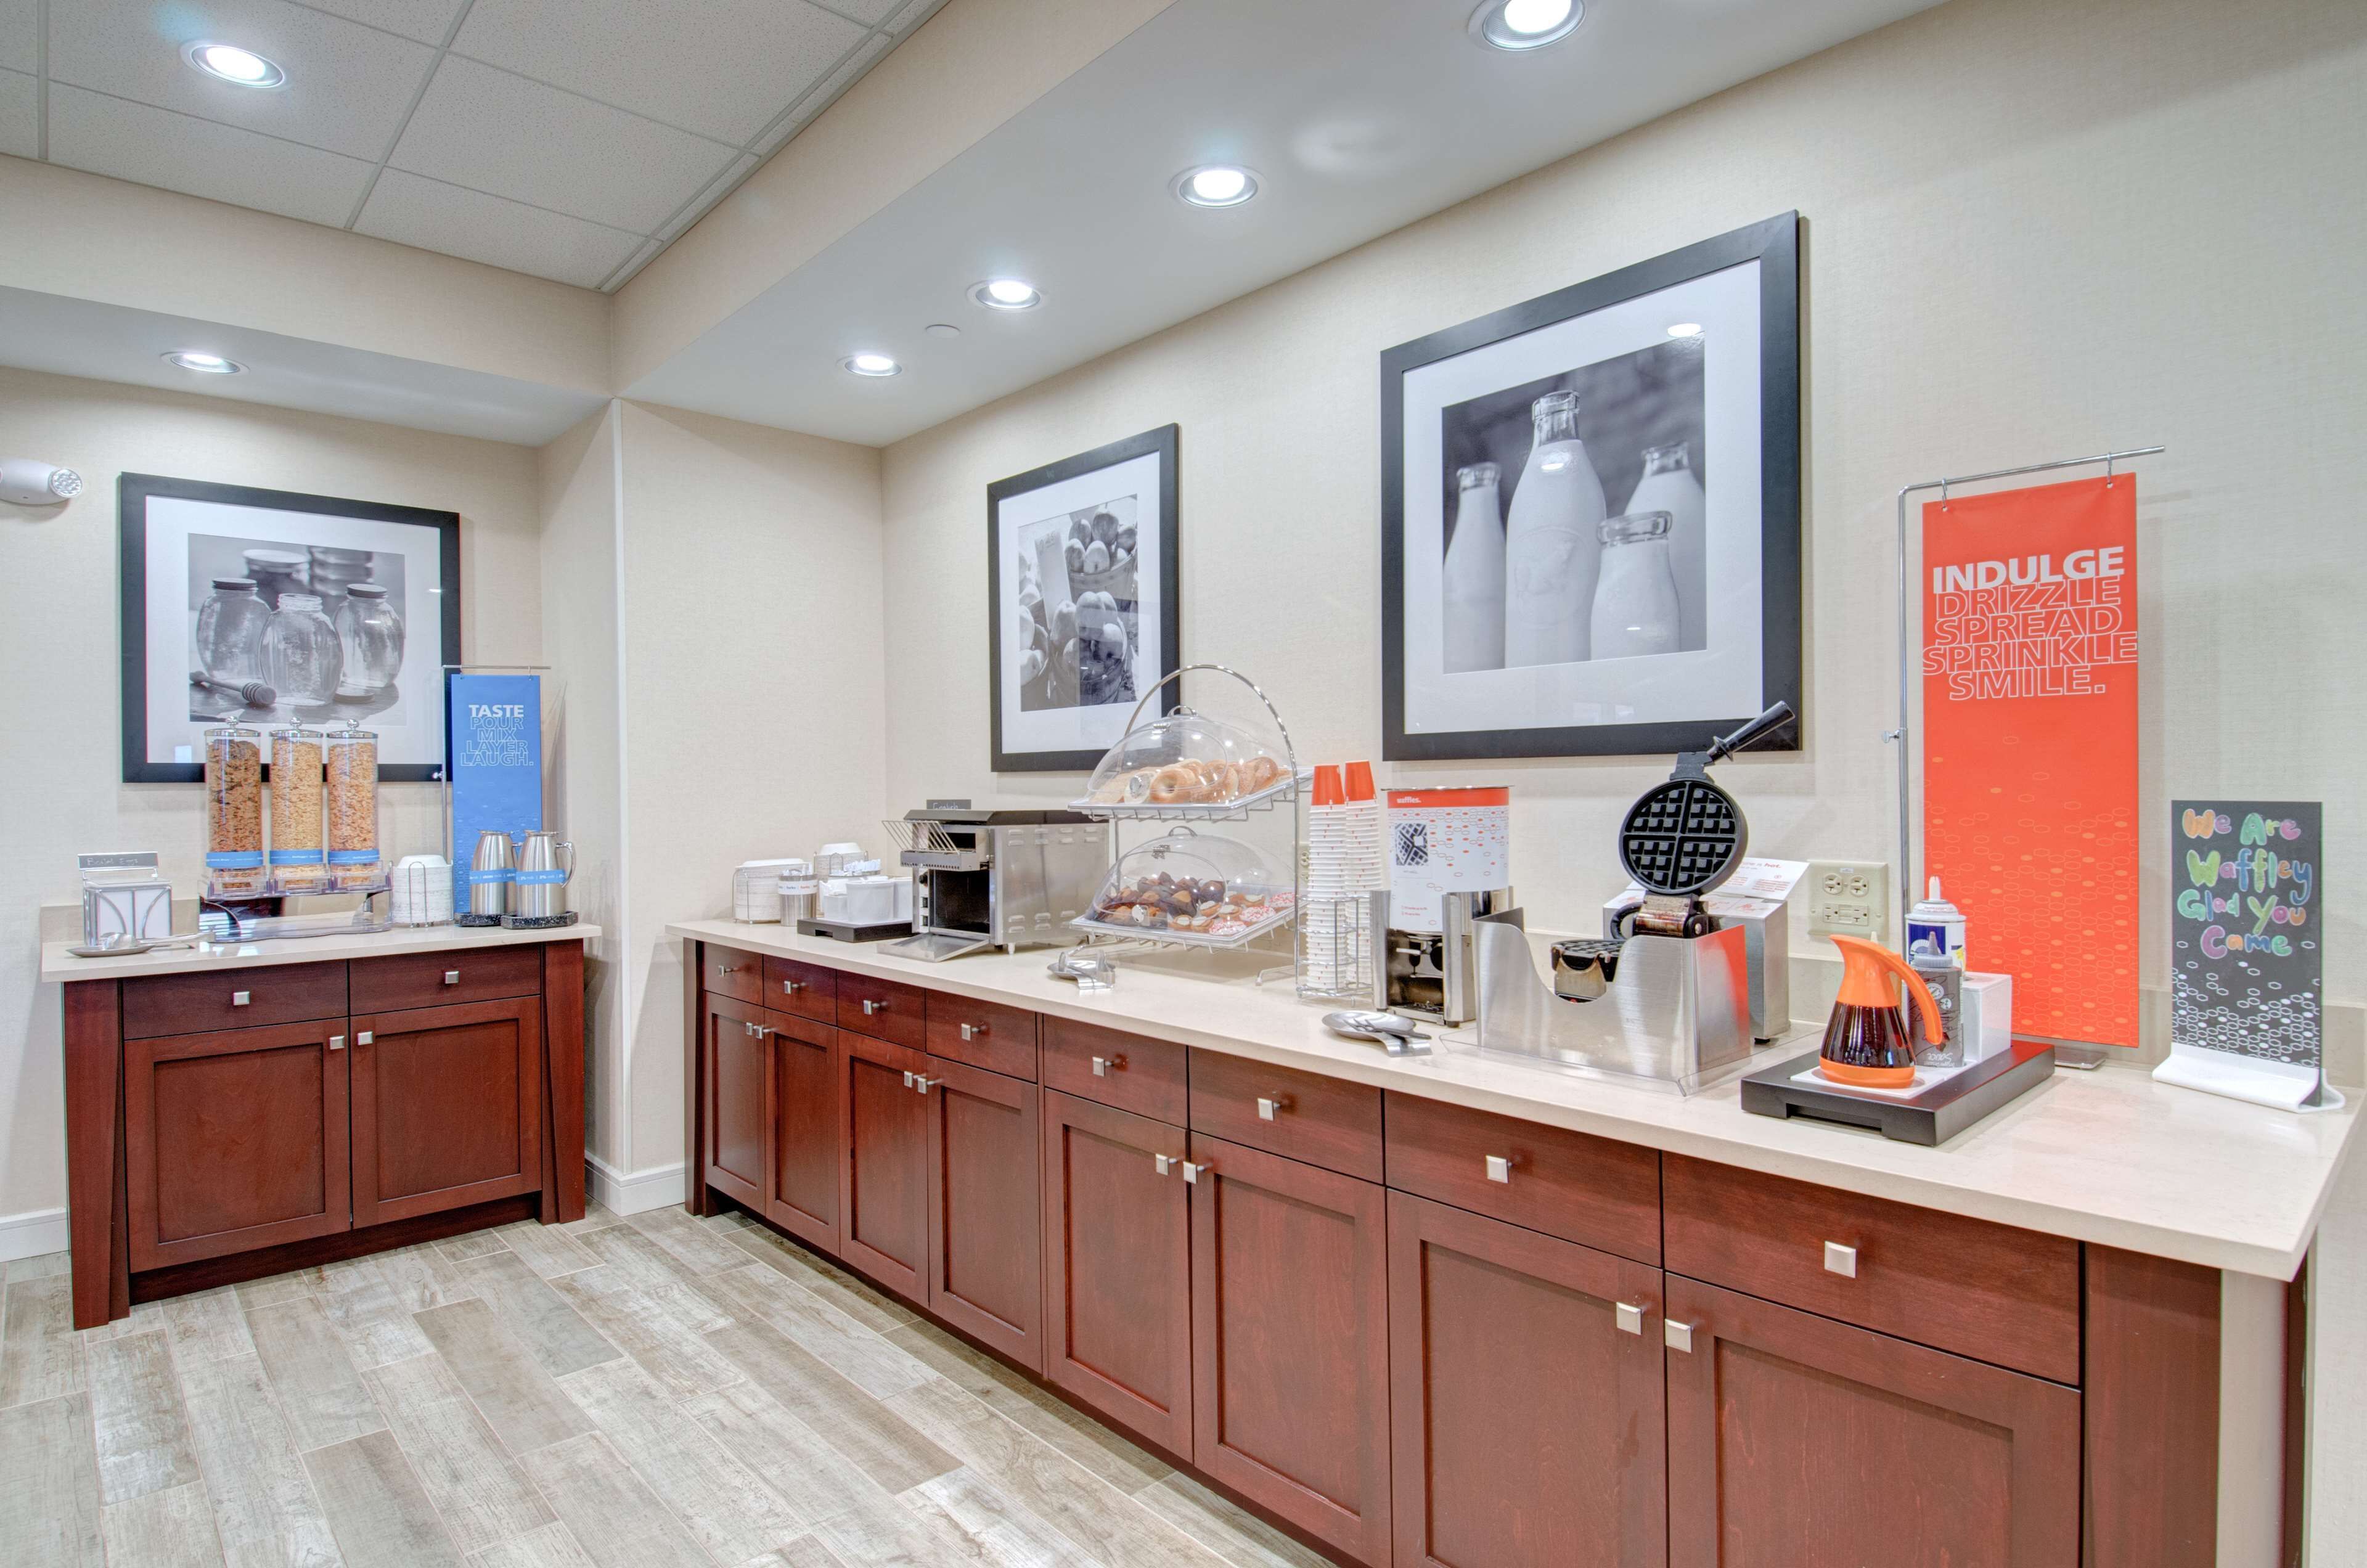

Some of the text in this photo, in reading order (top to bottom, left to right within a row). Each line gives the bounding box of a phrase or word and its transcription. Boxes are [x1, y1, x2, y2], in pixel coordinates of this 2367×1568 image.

[1933, 546, 2125, 594] INDULGE
[1936, 574, 2121, 621] DRIZZLE
[1934, 605, 2122, 647] SPREAD
[1922, 631, 2138, 676] SPRINKLE
[1948, 663, 2106, 701] SMILE.
[468, 704, 524, 717] TASTE
[470, 716, 524, 730] POUR
[467, 740, 529, 754] LAYER
[477, 728, 517, 741] MIX
[460, 752, 534, 766] LAUGH.
[2181, 808, 2302, 846] We Are
[2186, 847, 2312, 905] Waffley
[2177, 889, 2307, 936] Glad You
[2200, 925, 2293, 959] Came
